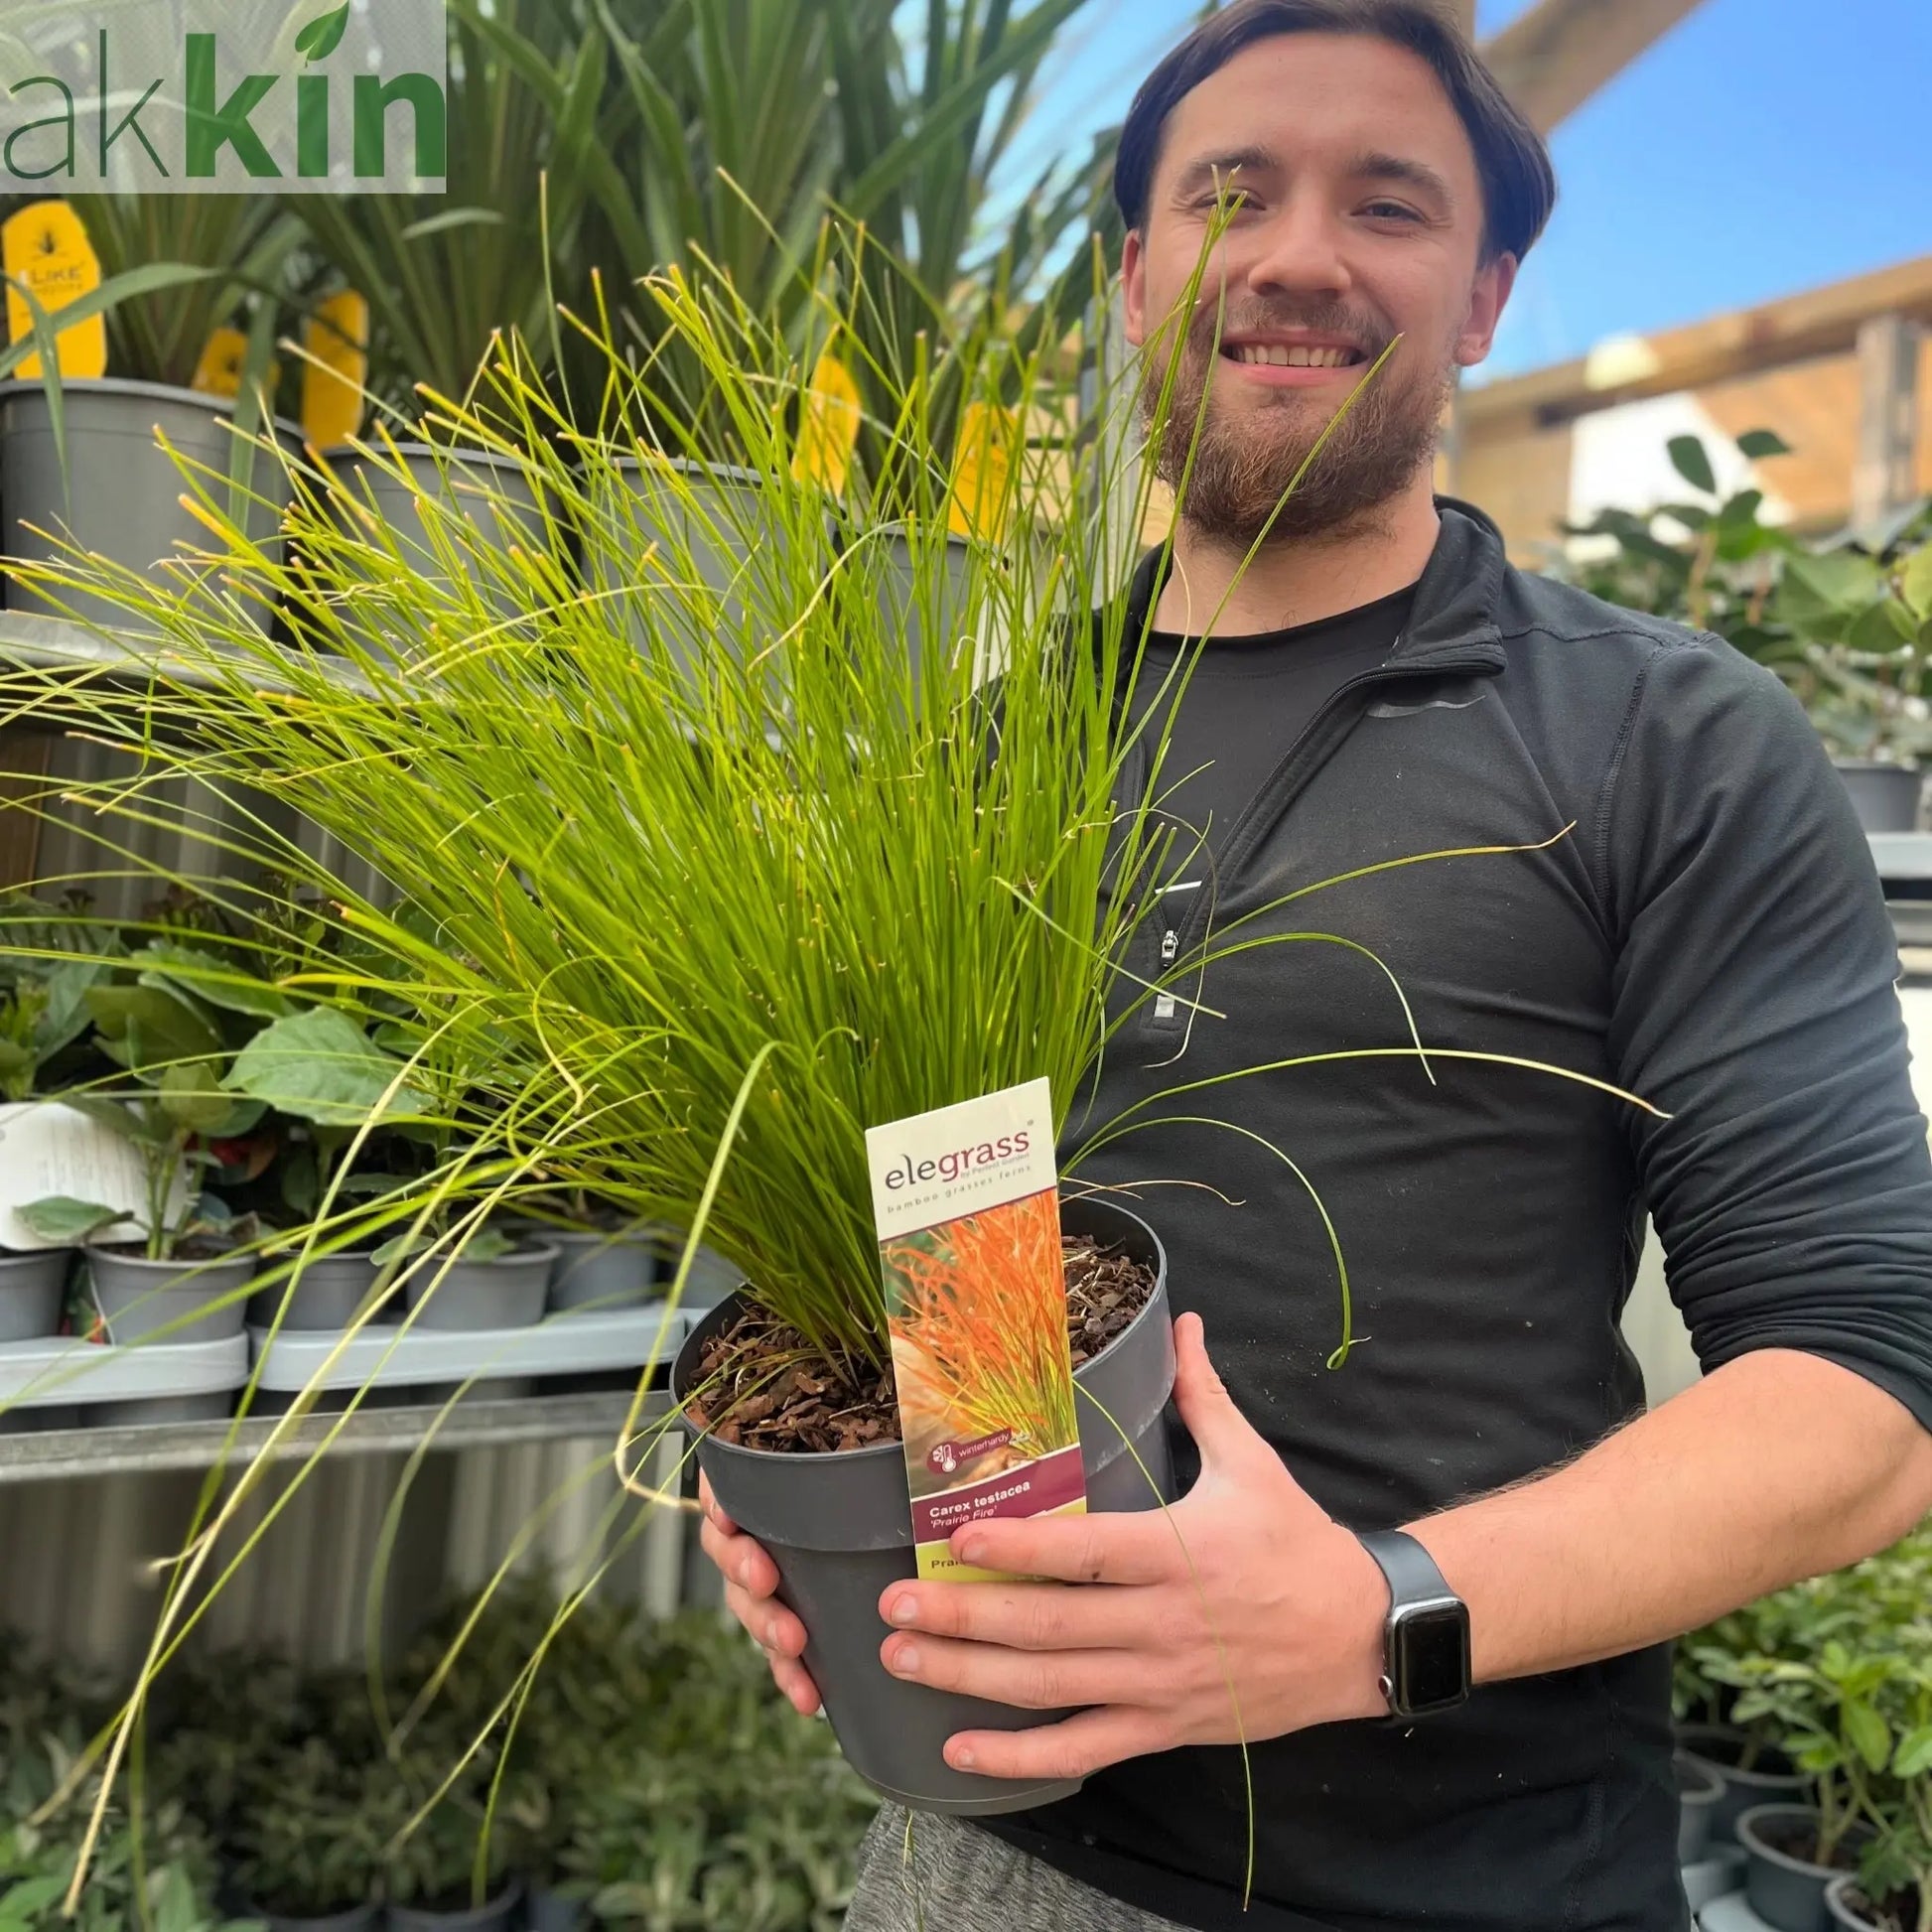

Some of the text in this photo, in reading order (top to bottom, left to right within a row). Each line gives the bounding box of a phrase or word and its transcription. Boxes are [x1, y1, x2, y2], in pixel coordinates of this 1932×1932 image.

[887, 1165, 1032, 1214] bamboo grasses ferns
[929, 1480, 1032, 1518] Carex testacea
